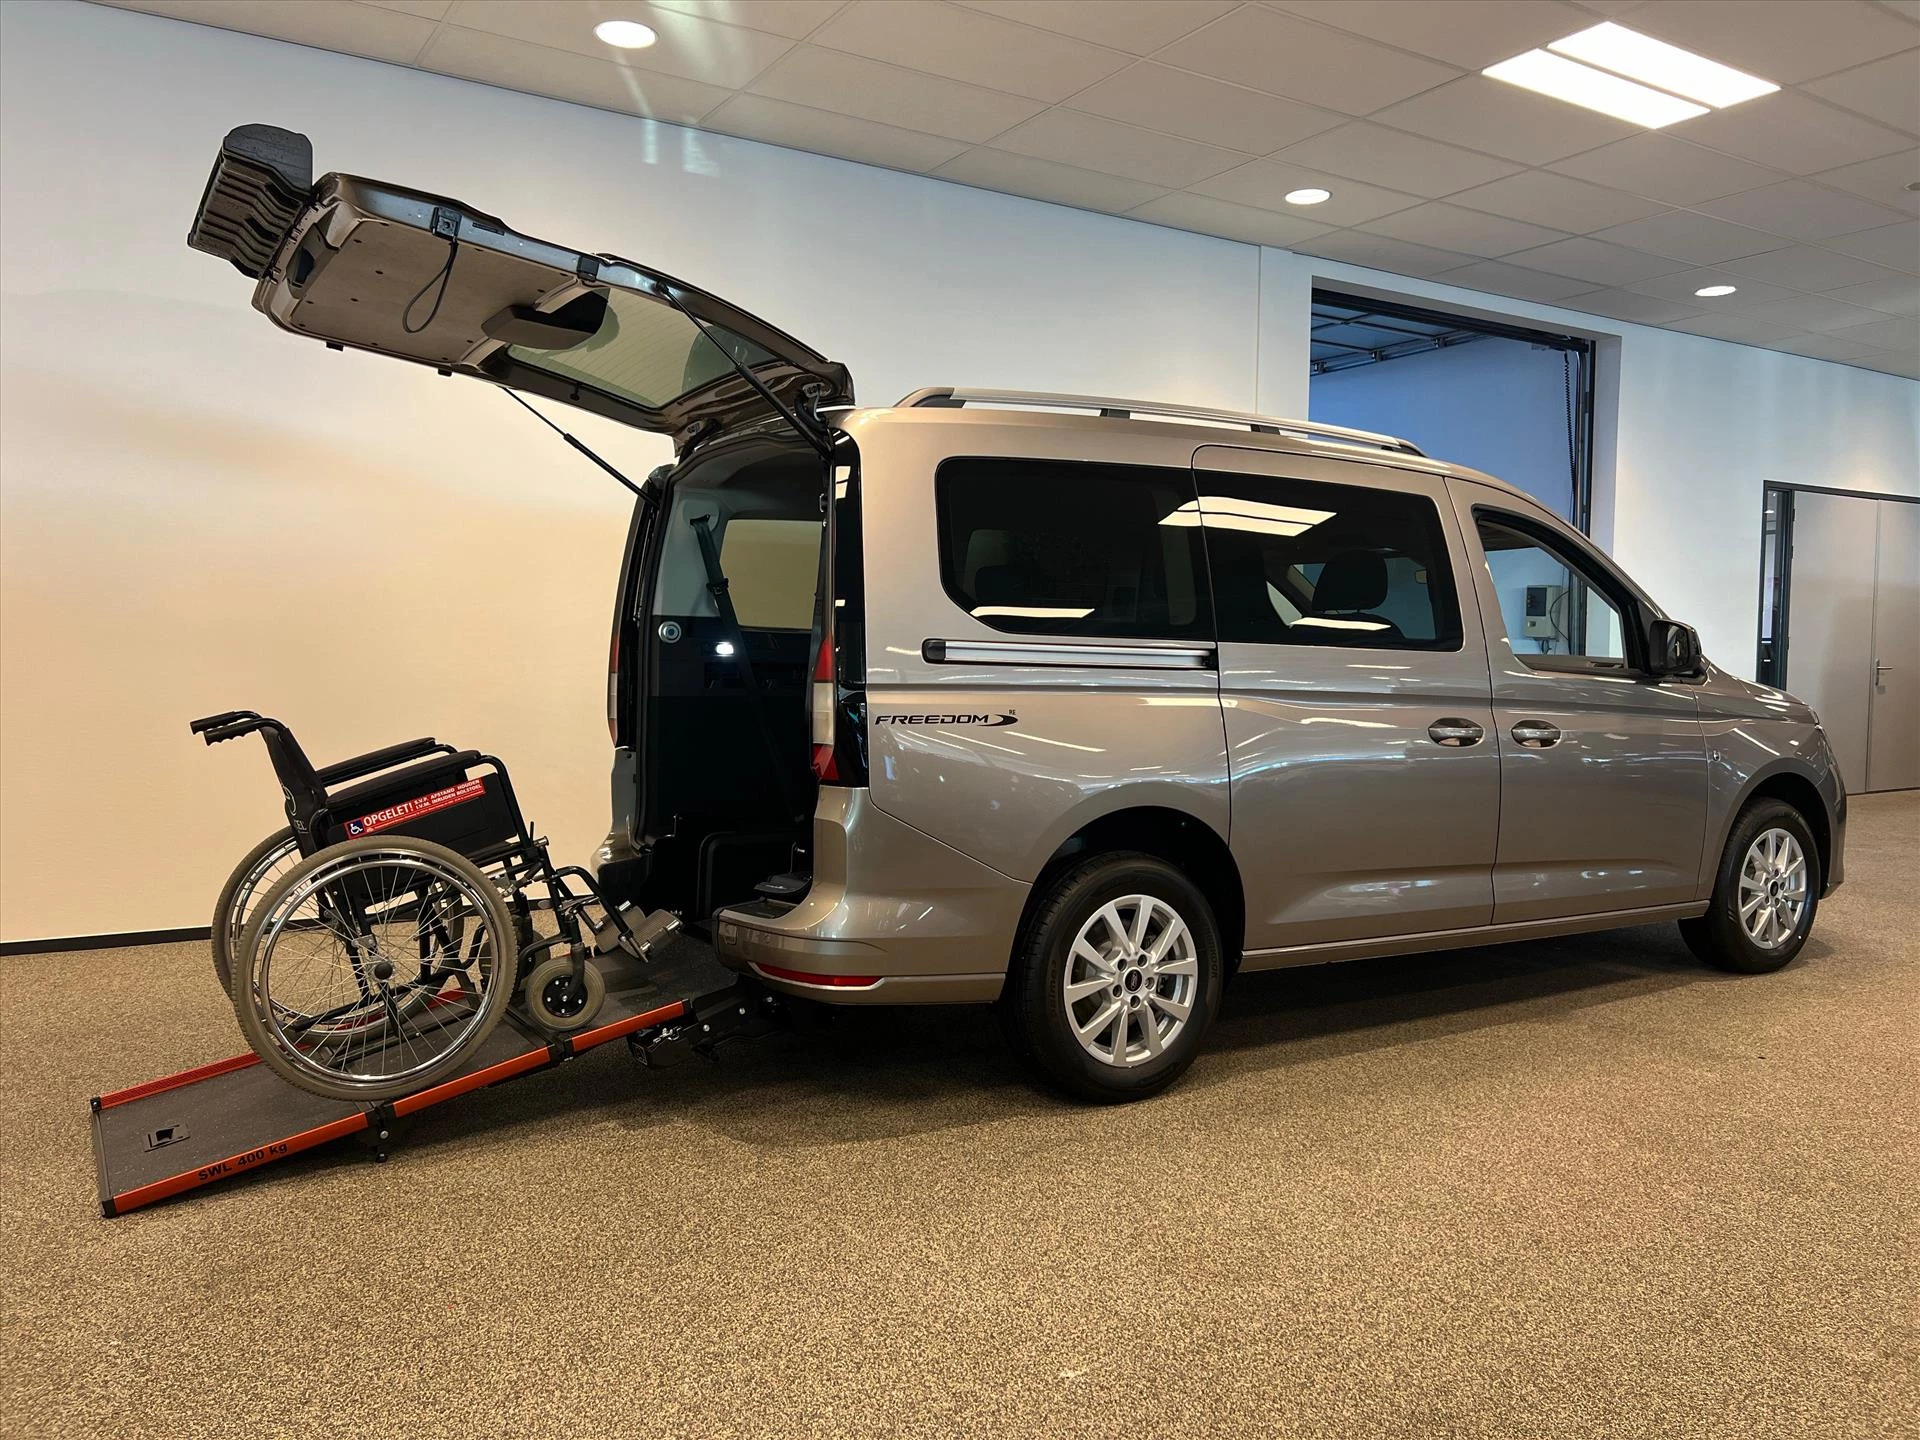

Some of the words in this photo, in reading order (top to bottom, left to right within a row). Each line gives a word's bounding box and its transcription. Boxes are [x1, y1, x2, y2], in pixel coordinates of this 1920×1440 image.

[874, 714, 990, 725] FREEDOM
[430, 786, 455, 799] AFSTAND
[457, 779, 480, 790] HOUDEN
[363, 803, 414, 827] OPGELET!
[198, 1163, 232, 1181] SWL
[237, 1149, 265, 1166] 400
[268, 1143, 287, 1156] kg
